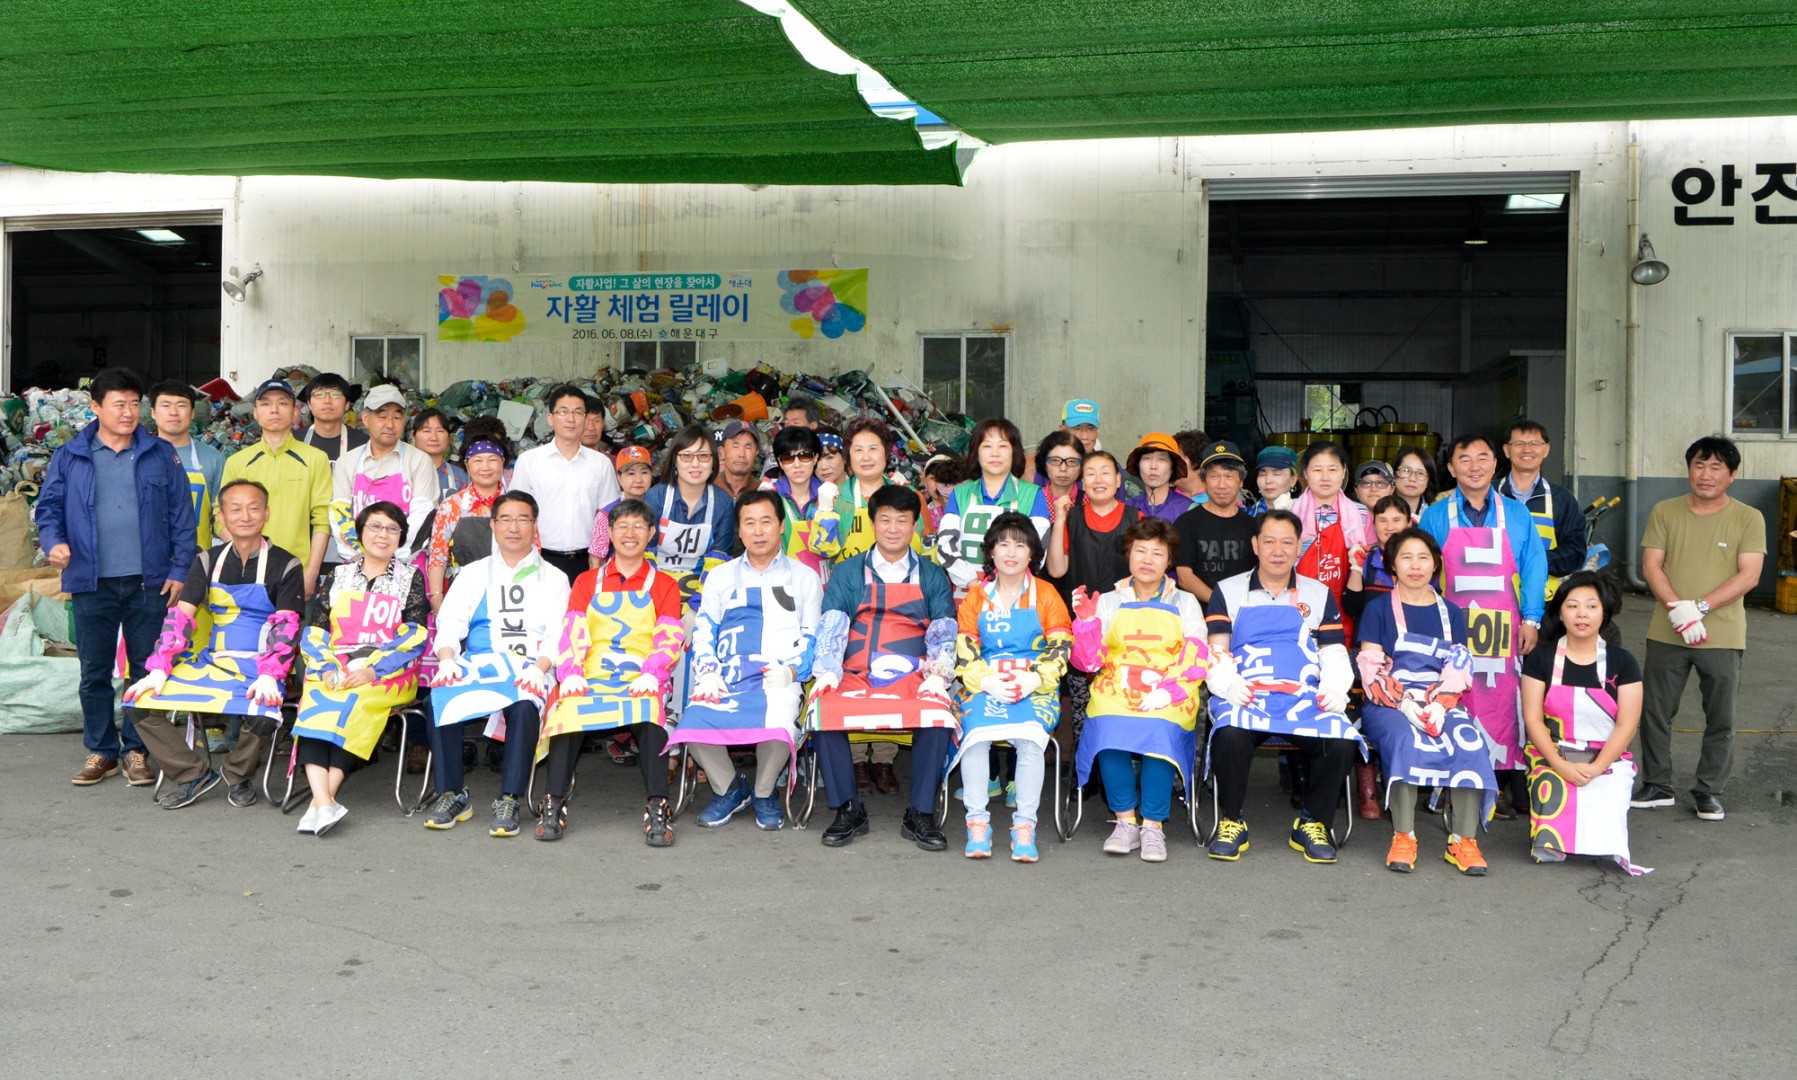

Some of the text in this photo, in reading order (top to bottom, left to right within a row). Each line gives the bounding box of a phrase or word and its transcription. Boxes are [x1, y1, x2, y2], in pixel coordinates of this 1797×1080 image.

[575, 277, 616, 290] 자활사업!
[620, 278, 629, 288] 그
[632, 277, 651, 289] 삶의
[655, 276, 683, 289] 현장을
[686, 275, 715, 288] 찾아서
[546, 293, 748, 324] 자활 체험 릴레이
